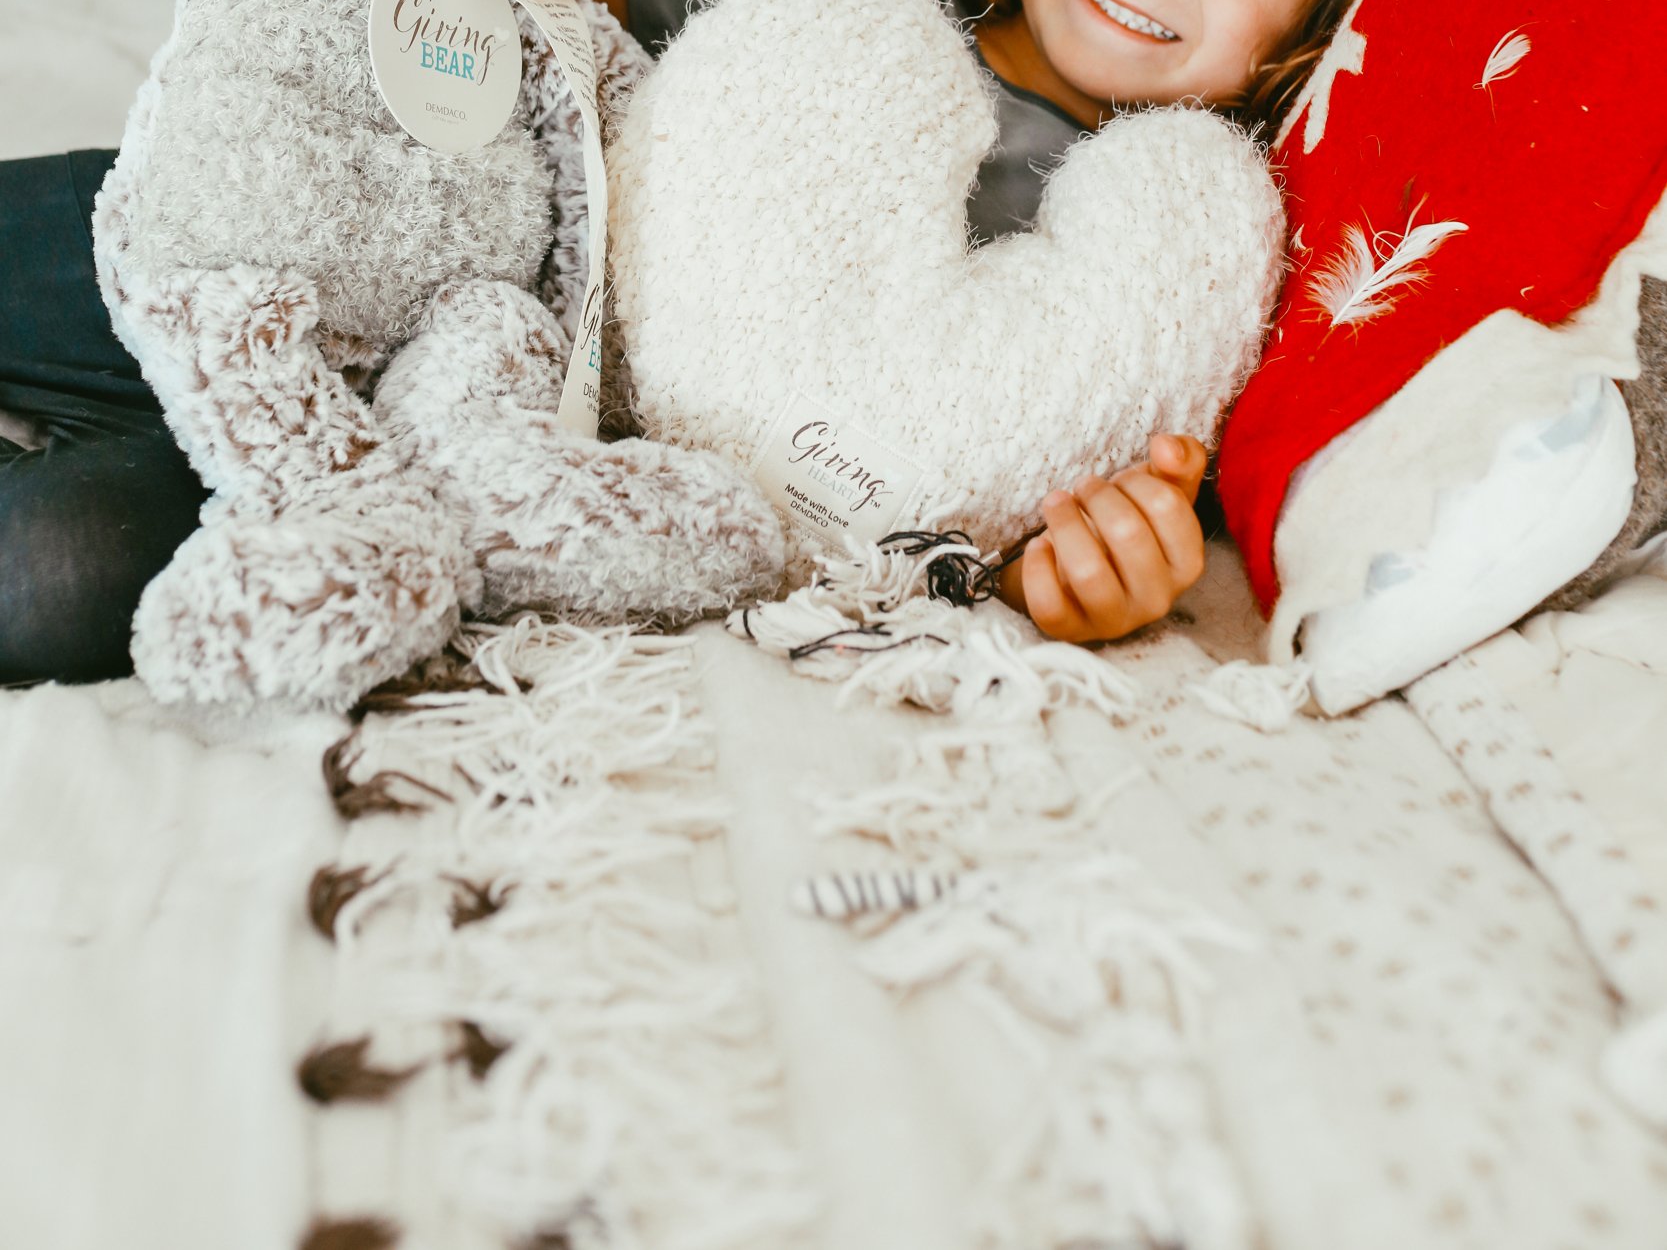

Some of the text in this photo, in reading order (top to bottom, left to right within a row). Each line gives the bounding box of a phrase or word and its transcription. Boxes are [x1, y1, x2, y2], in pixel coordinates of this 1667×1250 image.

[420, 41, 476, 80] BEAR
[788, 421, 893, 512] Giving
[808, 465, 857, 502] HEART
[784, 483, 850, 528] Made with Love
[790, 500, 829, 528] DEMDACO
